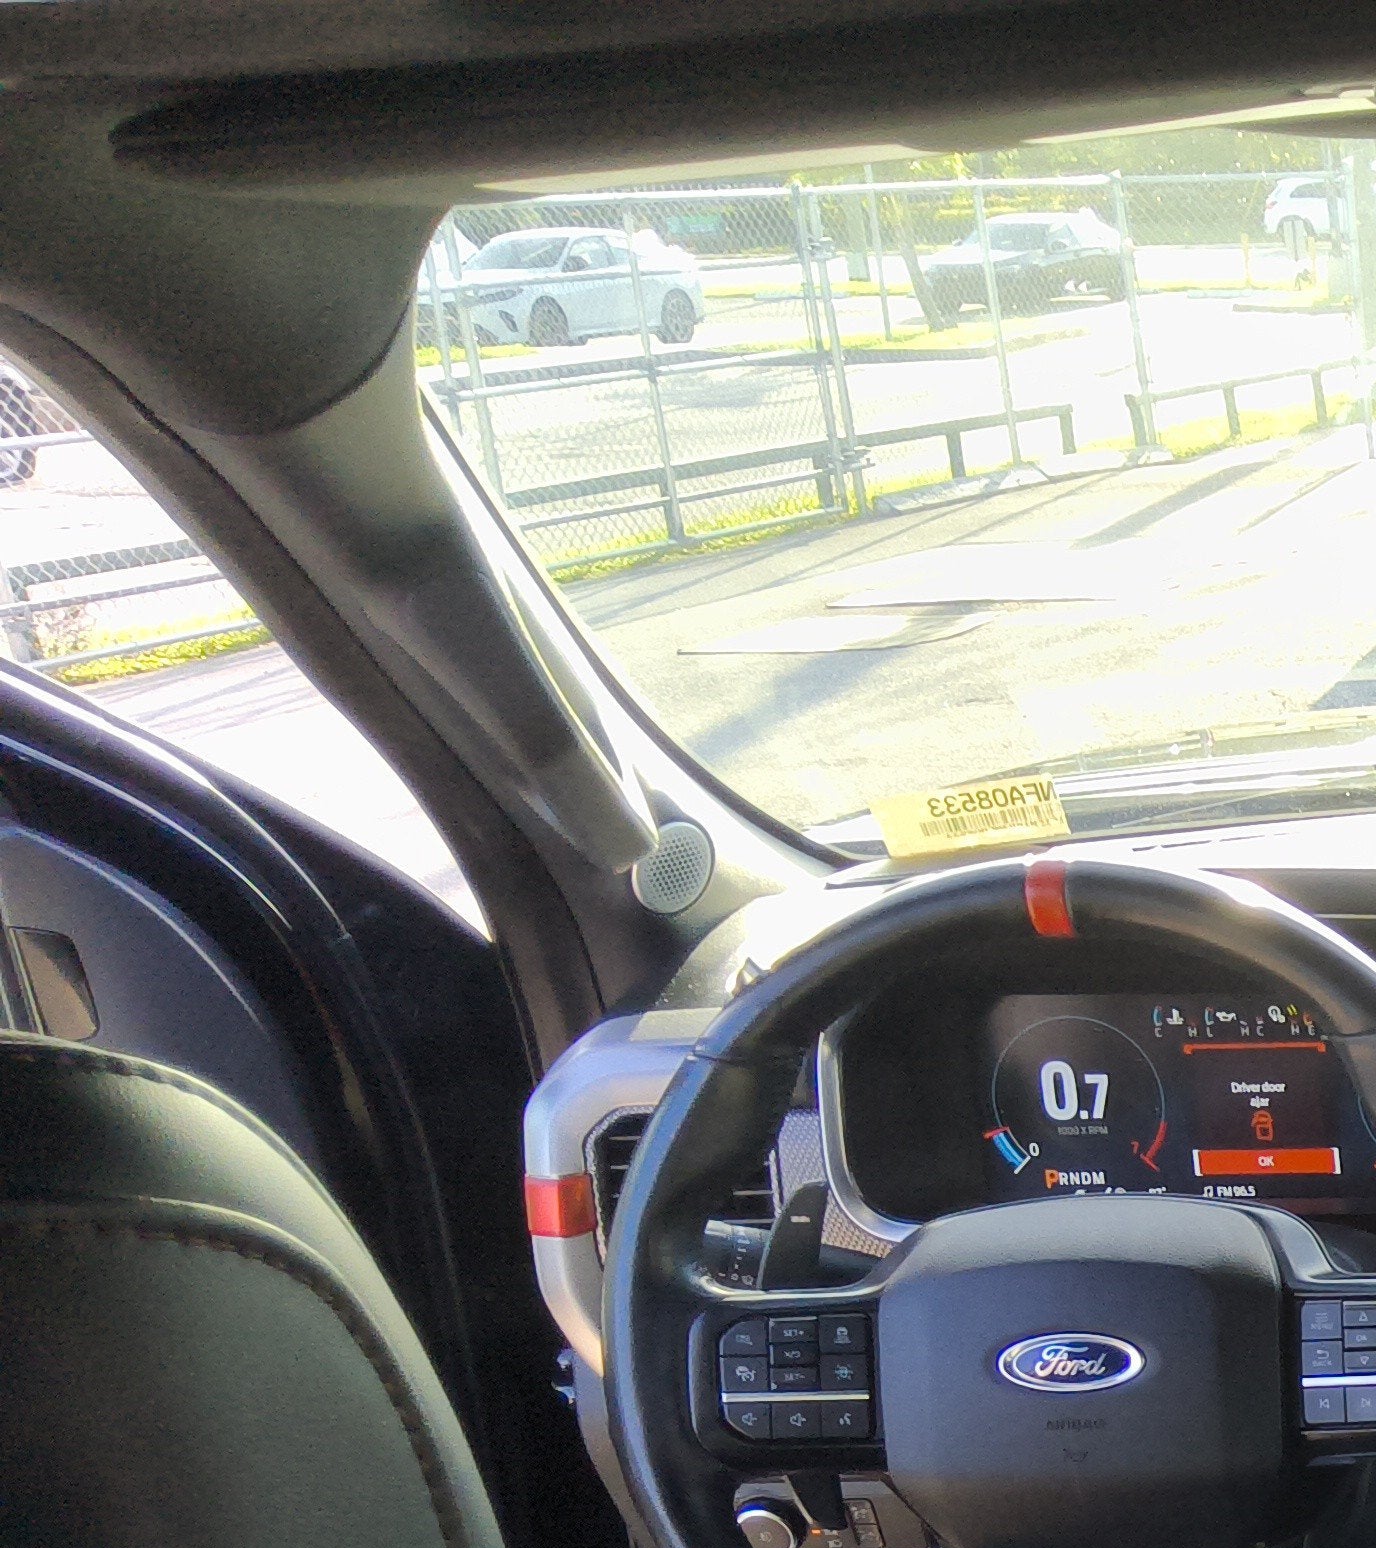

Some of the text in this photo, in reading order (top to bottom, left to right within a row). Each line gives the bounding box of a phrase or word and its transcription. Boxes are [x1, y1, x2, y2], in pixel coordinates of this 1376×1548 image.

[1040, 1060, 1109, 1121] 0.7
[1230, 1081, 1286, 1093] Driver door
[1029, 1142, 1040, 1157] 0
[1257, 1156, 1275, 1167] OK
[1034, 1345, 1107, 1377] Ford
